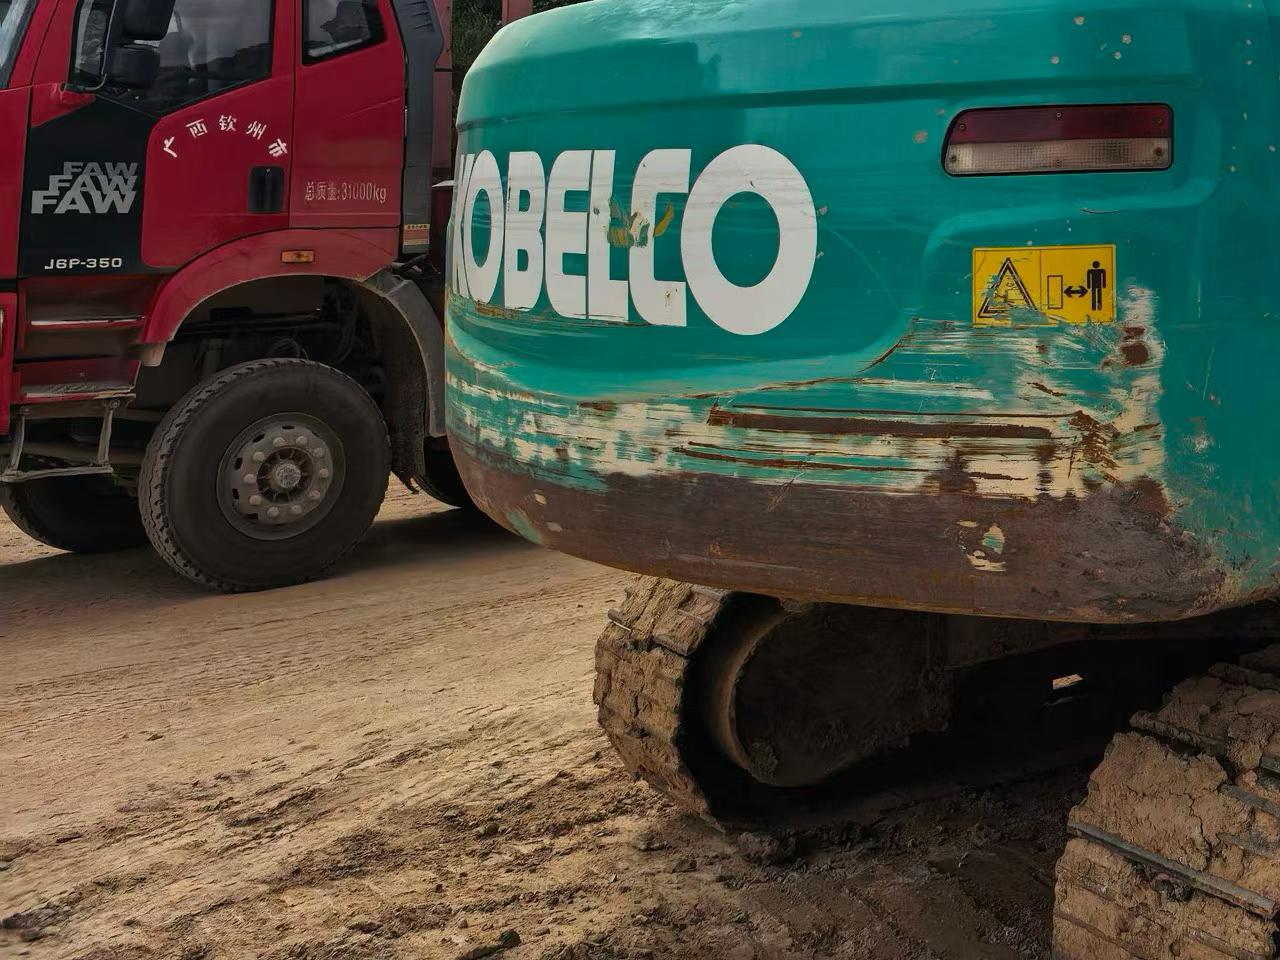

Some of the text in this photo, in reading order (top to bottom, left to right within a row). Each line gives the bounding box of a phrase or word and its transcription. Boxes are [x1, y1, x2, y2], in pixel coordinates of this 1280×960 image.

[163, 114, 288, 158] 广西钦州市
[31, 190, 137, 214] FAW
[452, 143, 818, 336] KOBELCO
[44, 257, 122, 270] J6P-350
